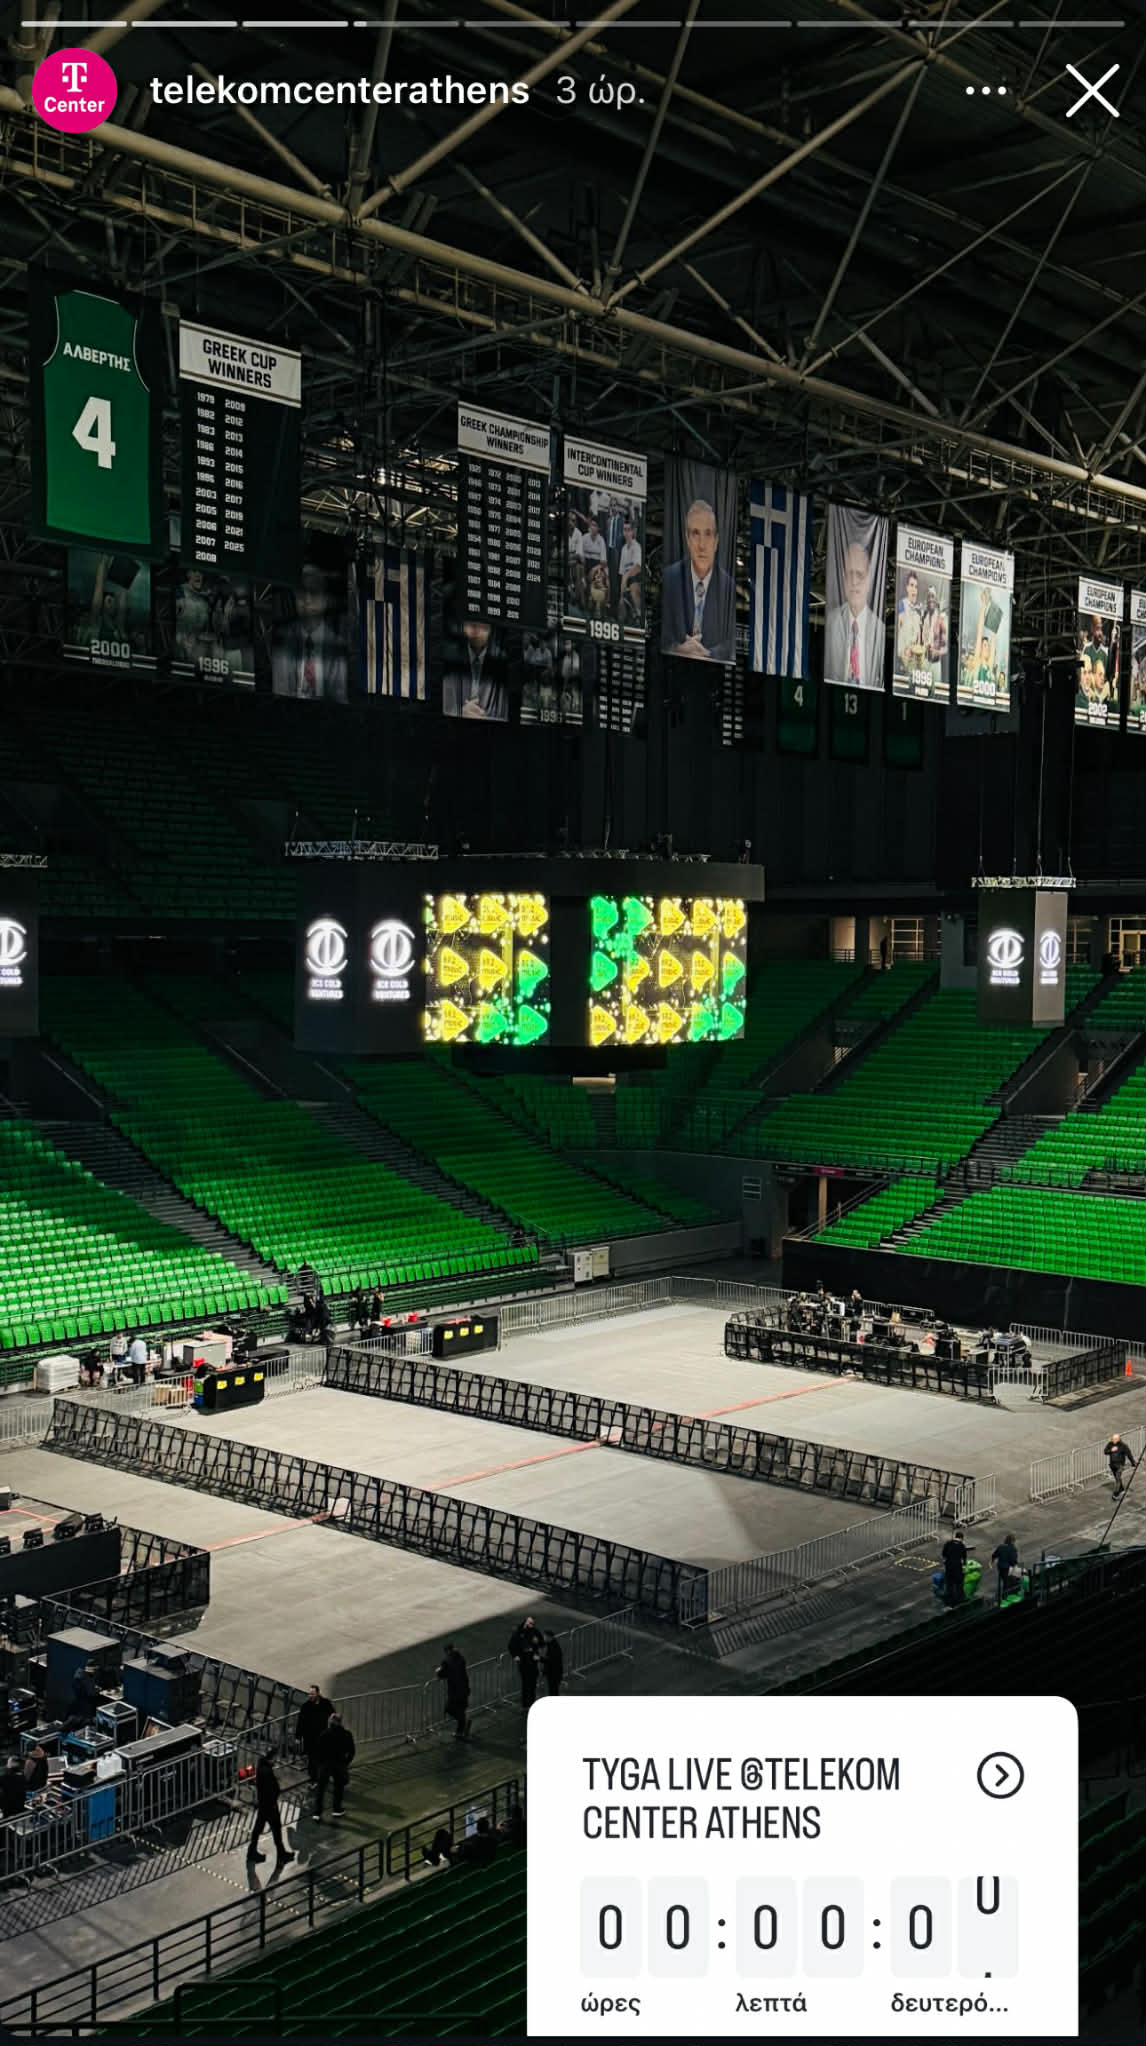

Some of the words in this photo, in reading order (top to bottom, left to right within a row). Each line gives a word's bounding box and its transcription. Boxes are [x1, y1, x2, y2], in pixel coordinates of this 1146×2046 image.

[63, 342, 132, 372] ΑΛΒΕΡΤΗΣ
[203, 338, 247, 364] GREEK
[251, 351, 277, 371] CUP
[208, 358, 272, 388] WINNERS
[197, 392, 215, 404] 1979
[225, 414, 244, 427] 2012
[72, 396, 116, 469] 4
[225, 430, 244, 443] 2013
[460, 415, 487, 433] GREEK
[489, 423, 549, 449] CHAMPIONSHIP
[486, 435, 524, 455] WINNERS
[225, 462, 244, 474] 2015
[567, 447, 644, 478] INTERCONTINENTAL
[577, 463, 595, 479] CUP
[596, 468, 633, 488] WINNERS
[225, 494, 243, 505] 2017
[225, 525, 243, 537] 2021
[195, 535, 216, 547] 2007
[224, 541, 245, 552] 2025
[907, 537, 944, 558] EUROPEAN
[904, 551, 946, 570] CHAMPIONS
[968, 564, 1007, 584] CHAMPIONS
[589, 619, 620, 641] 1996
[90, 639, 131, 659] 2000
[199, 656, 229, 675] 1996
[794, 685, 804, 707] 4
[973, 680, 996, 697] 2000
[844, 693, 858, 715] 13
[1088, 702, 1108, 717] 2002
